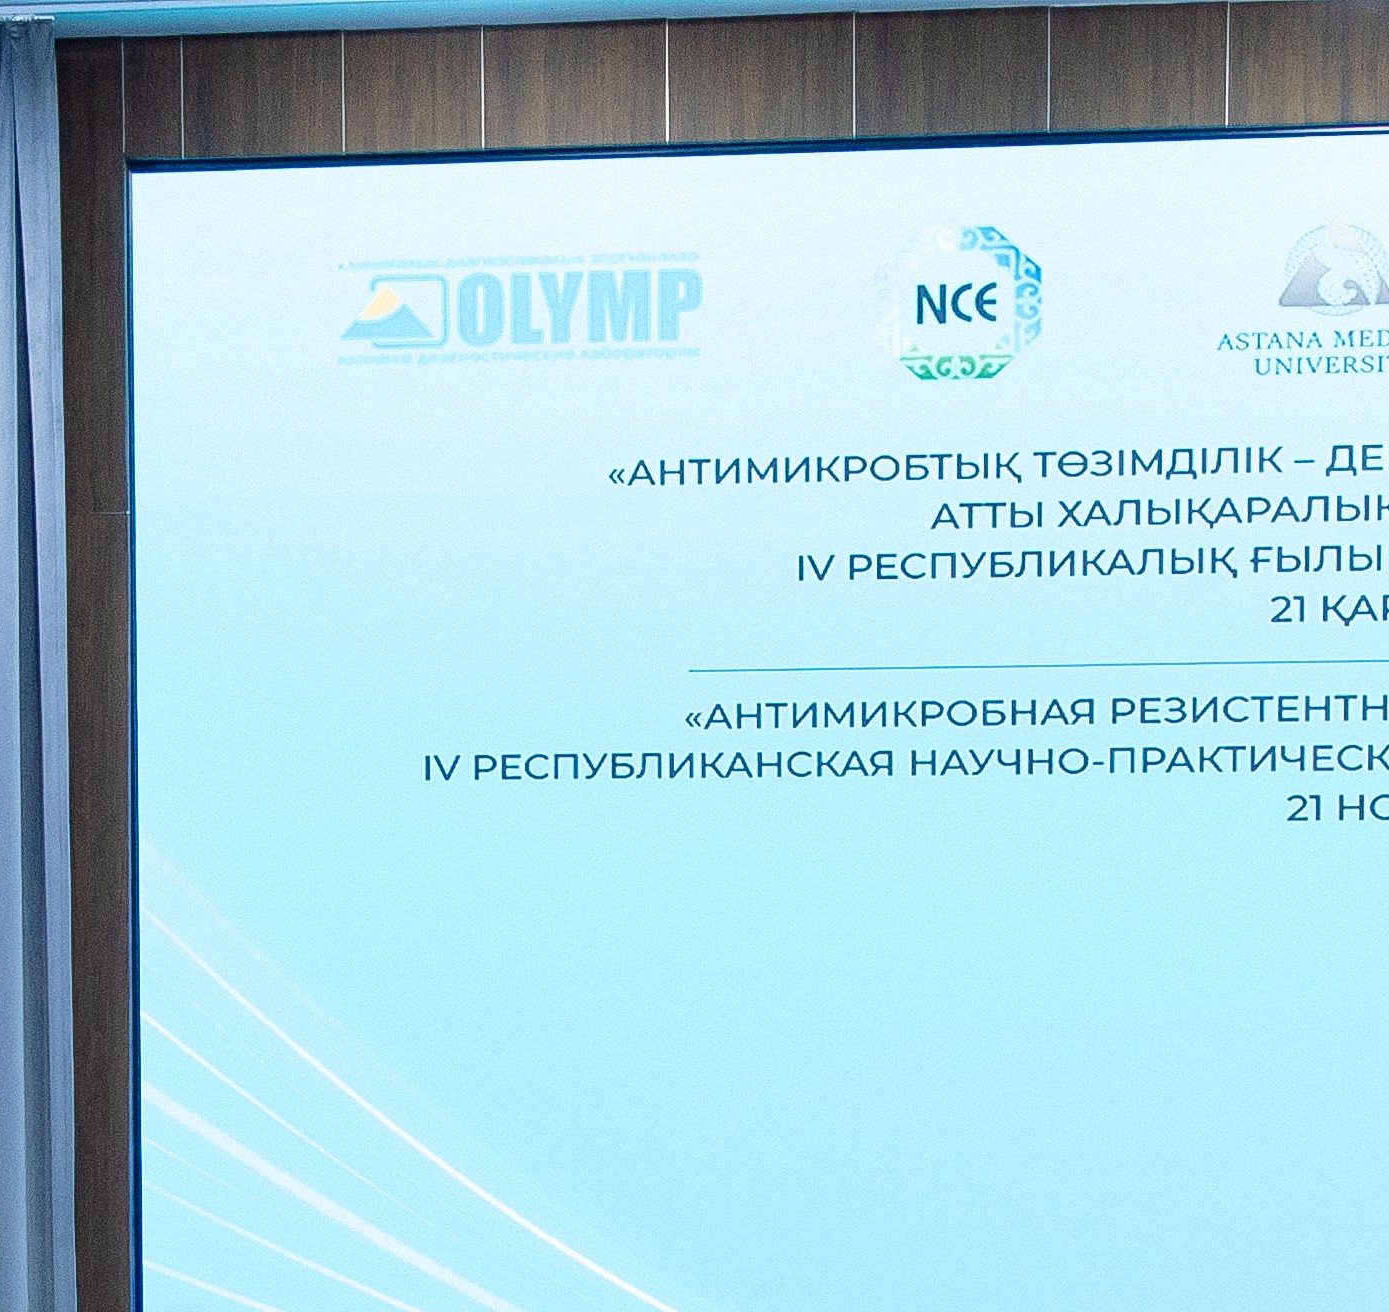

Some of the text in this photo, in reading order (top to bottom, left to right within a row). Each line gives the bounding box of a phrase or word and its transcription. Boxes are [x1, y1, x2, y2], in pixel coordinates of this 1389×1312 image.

[457, 268, 703, 347] OLYMP
[917, 282, 997, 324] NCE
[1218, 331, 1322, 350] ASTANA
[609, 452, 1022, 486] «АНТИМИКРОБТЫҚ
[1033, 446, 1282, 480] ТӨЗІМДІЛІК
[931, 501, 1042, 529] АТТЫ
[799, 554, 834, 581] IV
[850, 547, 1237, 581] РЕСПУБЛИКАЛЫҚ
[1271, 595, 1304, 622] 21
[686, 698, 1094, 729] «АНТИМИКРОБНАЯ
[425, 754, 460, 781] IV
[475, 750, 893, 780] РЕСПУБЛИКАНСКАЯ
[1287, 794, 1321, 821] 21
